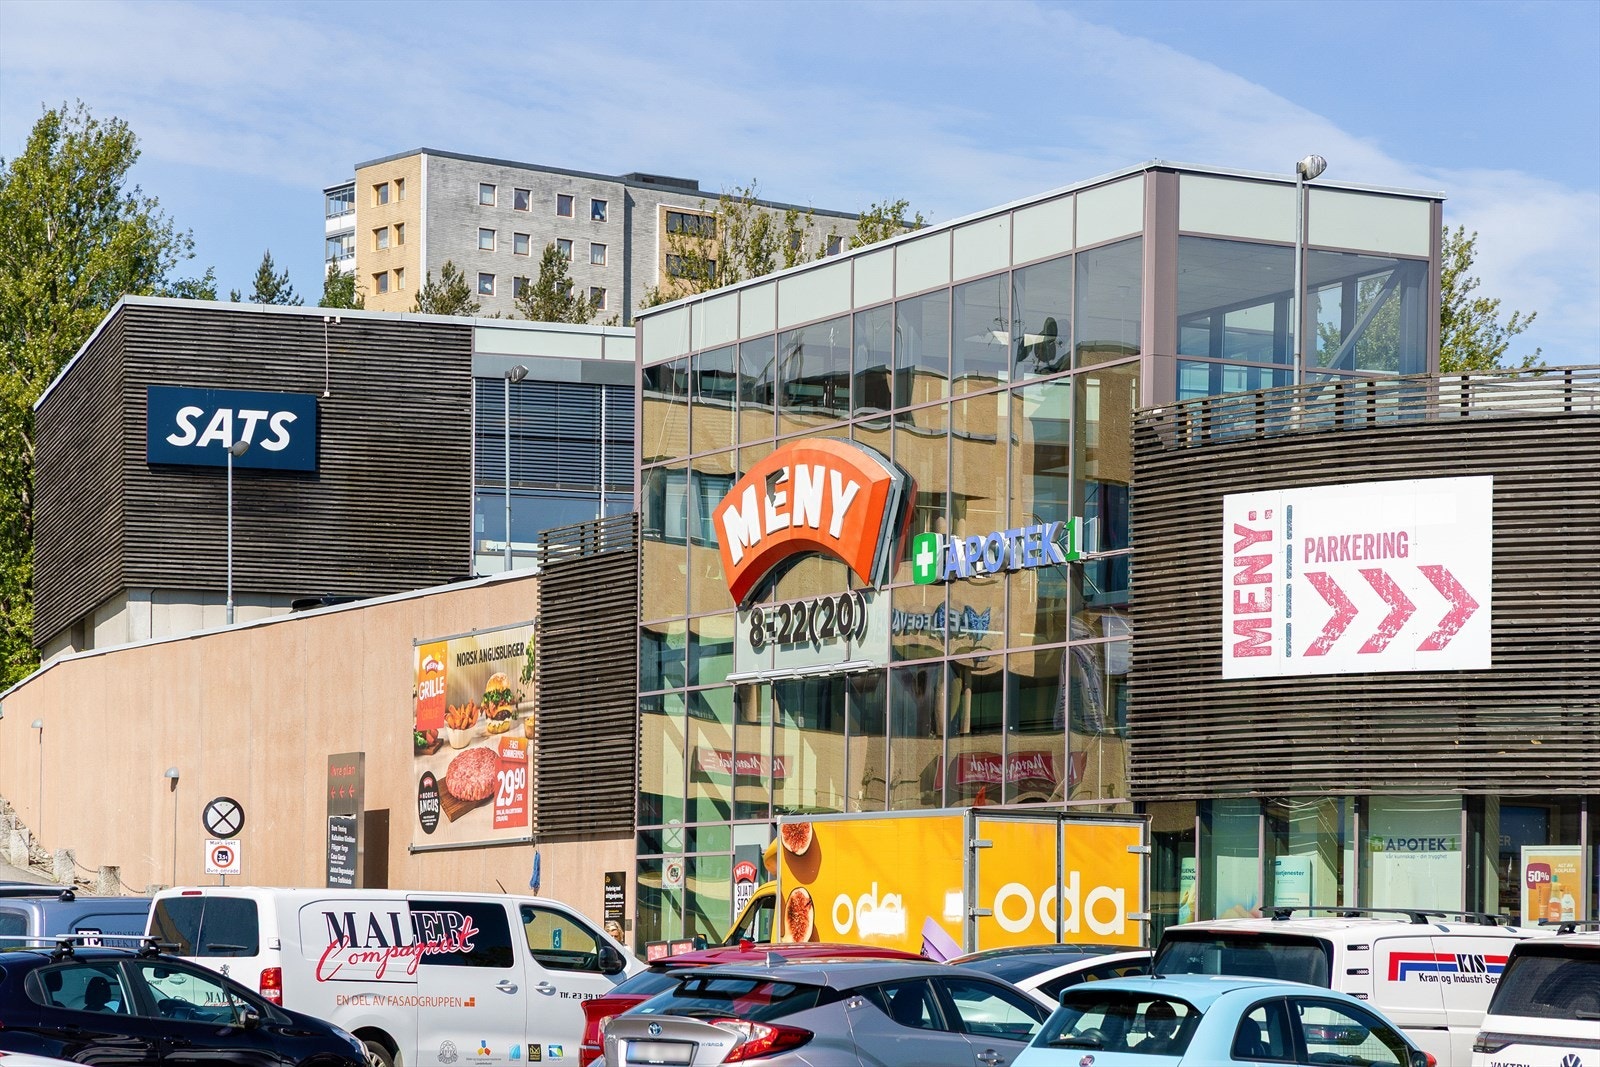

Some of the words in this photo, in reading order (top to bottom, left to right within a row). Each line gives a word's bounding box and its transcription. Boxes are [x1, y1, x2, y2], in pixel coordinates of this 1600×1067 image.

[166, 406, 298, 452] SATS
[722, 464, 860, 567] MENY
[943, 521, 1065, 581] APOTEK
[1065, 517, 1083, 562] 1
[1304, 531, 1409, 563] PARKERING
[1233, 509, 1273, 658] MENY:
[456, 649, 478, 667] NORSK
[479, 642, 525, 663] ANGUSBURGER
[419, 676, 445, 701] GRILLE
[419, 799, 439, 815] ANGUS
[1385, 838, 1447, 851] APOTEK
[1449, 837, 1458, 851] 1
[736, 864, 755, 877] MENY
[1527, 870, 1550, 882] 50%
[994, 871, 1125, 935] oda
[106, 939, 141, 948] ELEKTR
[322, 911, 474, 951] MALER
[1456, 953, 1486, 973] KIS
[1419, 973, 1439, 982] Kran
[1441, 974, 1452, 984] og
[1454, 974, 1483, 984] Industri
[336, 995, 349, 1006] EN
[351, 995, 370, 1006] DEL
[373, 995, 386, 1007] AV
[387, 996, 462, 1007] FASADGRUPPEN
